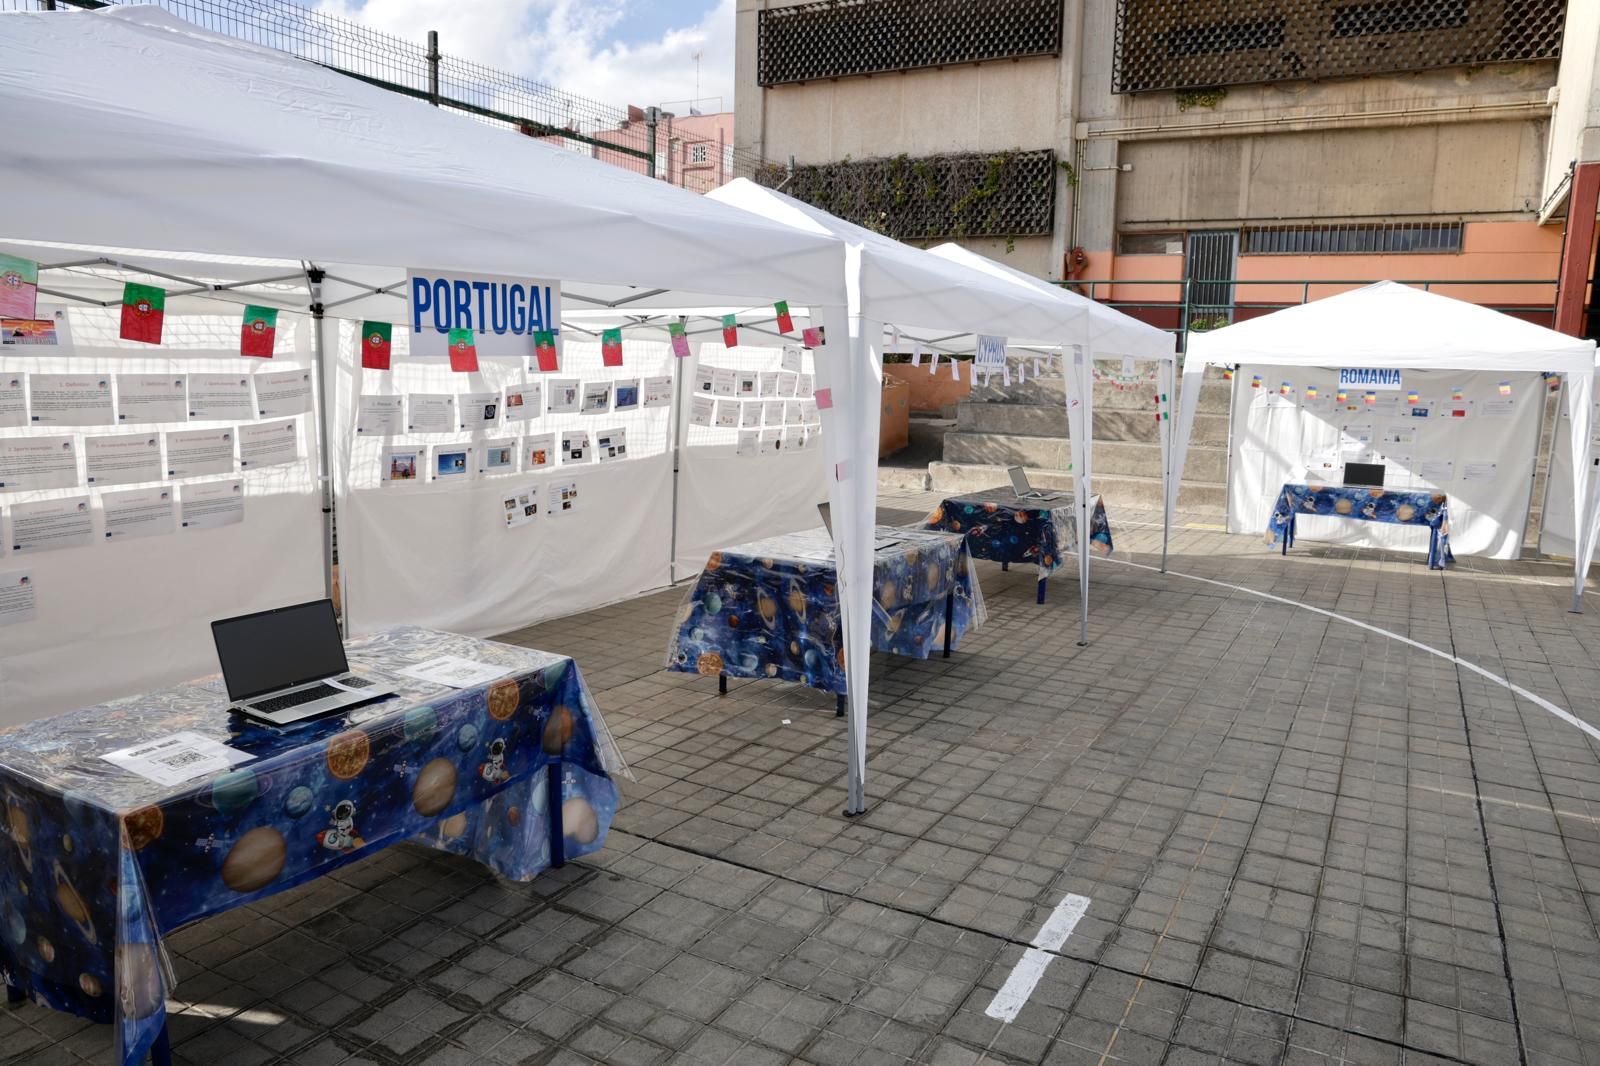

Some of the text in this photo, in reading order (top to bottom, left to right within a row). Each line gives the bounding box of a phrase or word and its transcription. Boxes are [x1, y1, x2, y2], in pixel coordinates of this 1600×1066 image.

[412, 277, 559, 335] PORTUGAL
[978, 336, 1005, 364] CYPRUS
[1340, 368, 1400, 384] ROMANIA
